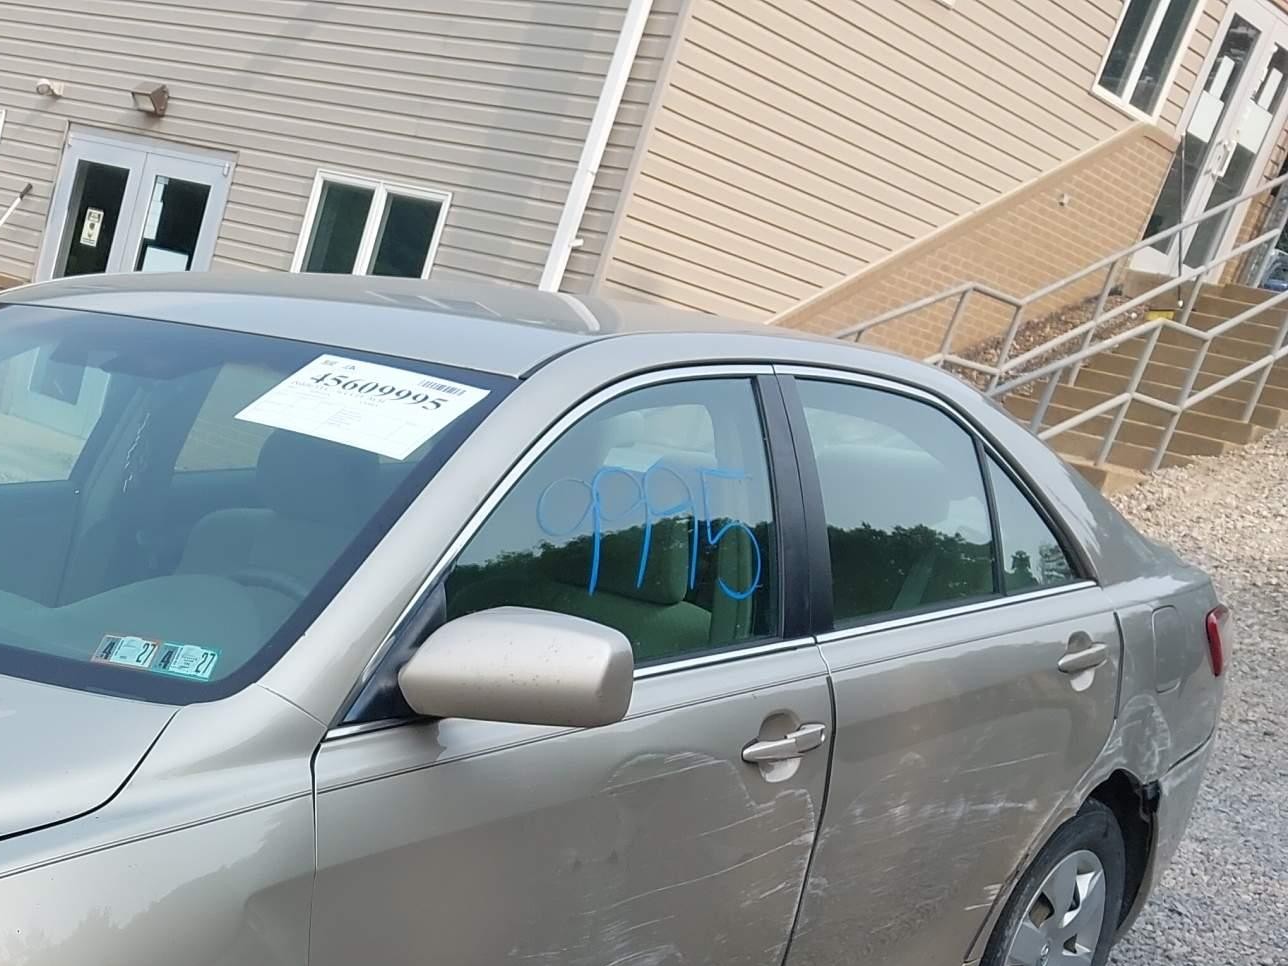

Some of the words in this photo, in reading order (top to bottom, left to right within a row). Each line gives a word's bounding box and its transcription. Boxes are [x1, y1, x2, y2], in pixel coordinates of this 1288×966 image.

[309, 371, 450, 412] 45609995
[536, 465, 762, 600] 9995
[135, 642, 158, 666] 27
[158, 650, 175, 670] 4
[194, 652, 217, 674] 27
